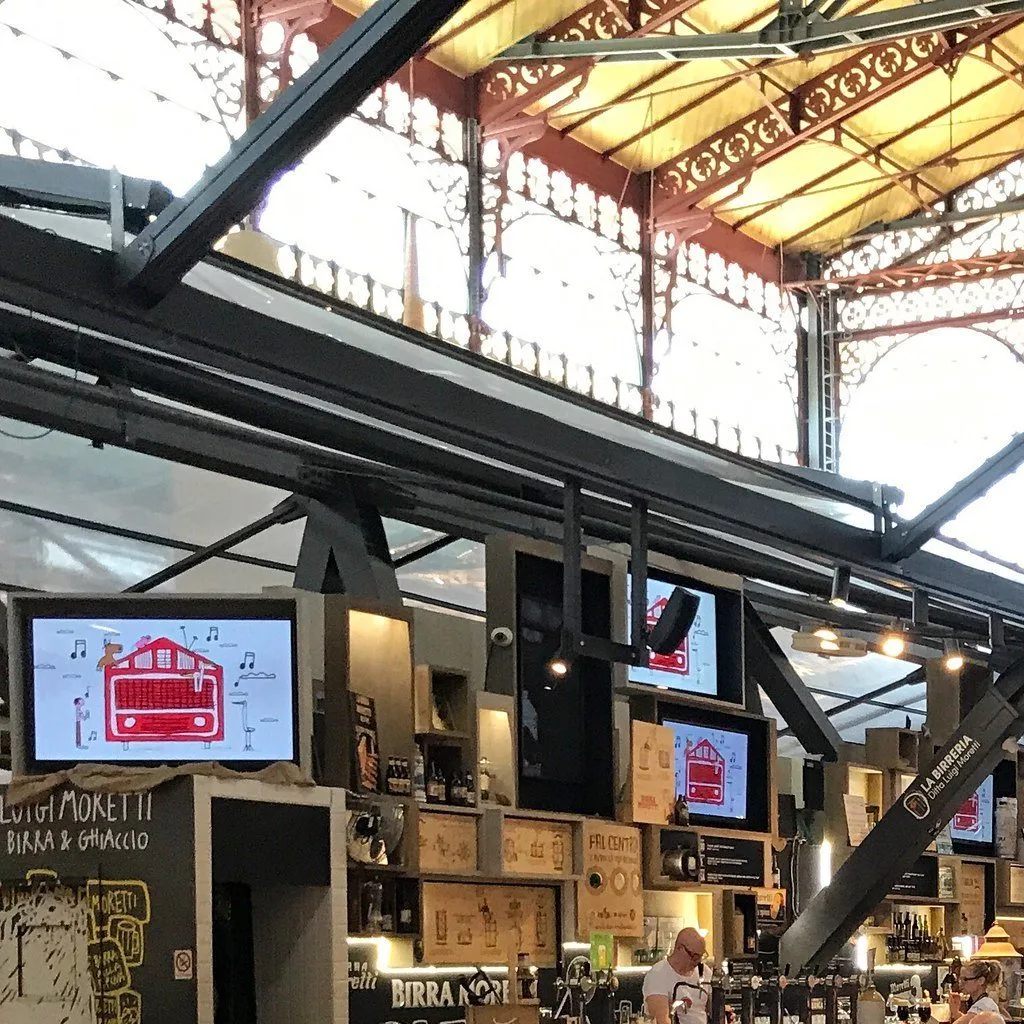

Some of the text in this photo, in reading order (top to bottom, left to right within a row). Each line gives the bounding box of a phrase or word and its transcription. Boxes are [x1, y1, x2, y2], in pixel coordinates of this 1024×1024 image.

[920, 735, 974, 793] LA BIRRERIA
[927, 784, 946, 800] Ditta
[942, 766, 960, 783] Luigi
[0, 790, 152, 824] LUIGI MORETTI
[8, 827, 149, 854] BIRRA & GHIACCIO
[391, 978, 454, 1009] BIRRA
